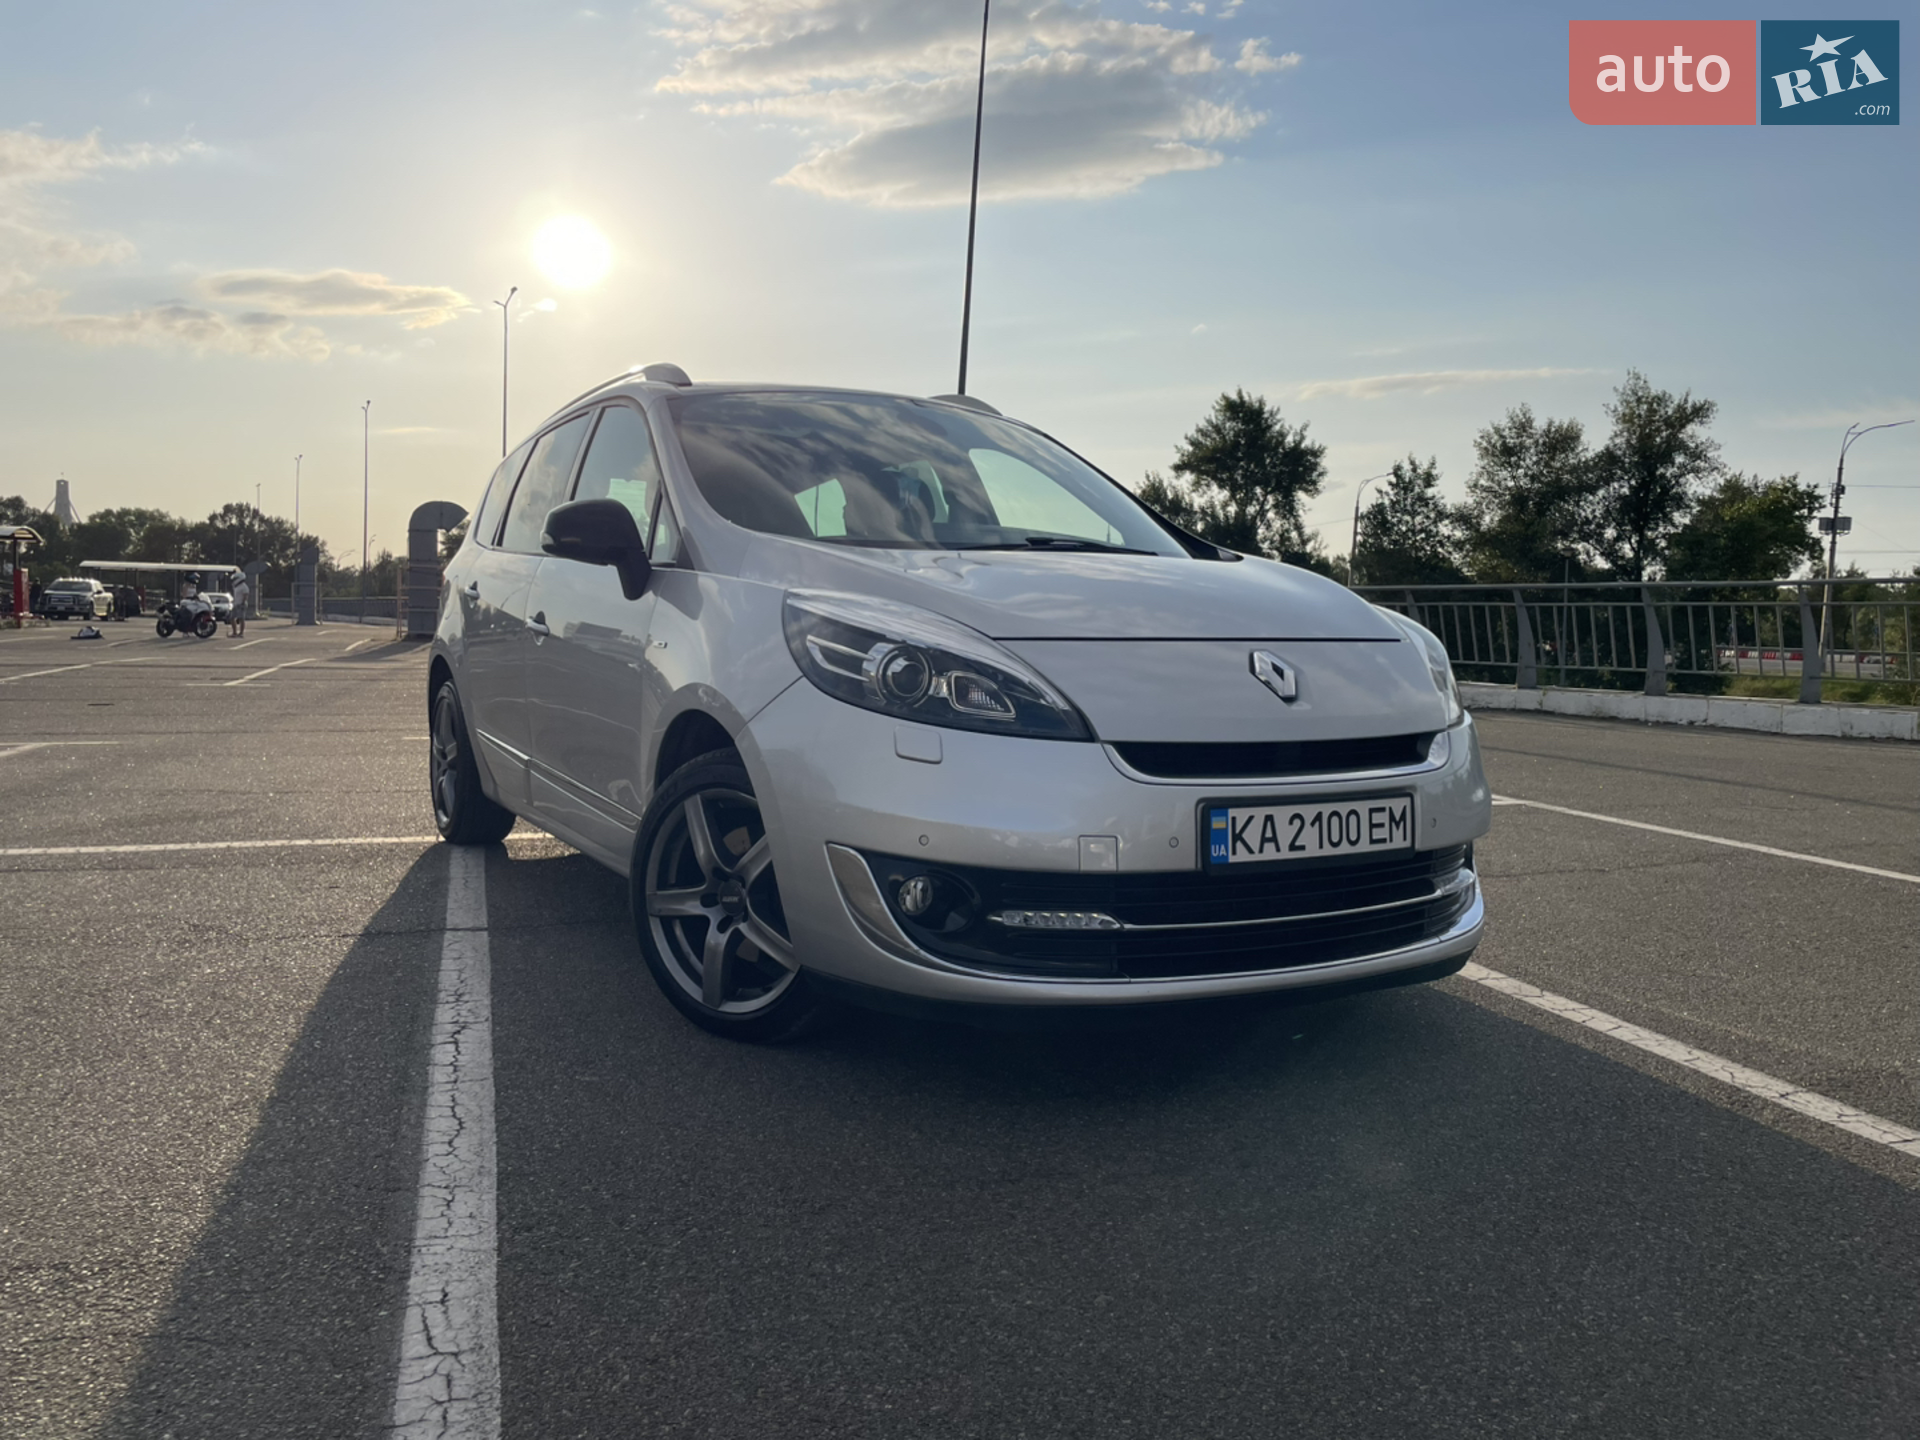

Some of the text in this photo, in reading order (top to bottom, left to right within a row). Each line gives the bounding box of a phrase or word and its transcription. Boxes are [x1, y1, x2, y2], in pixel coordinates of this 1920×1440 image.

[1231, 804, 1408, 856] KA 2100 EM
[1211, 844, 1228, 857] UA
